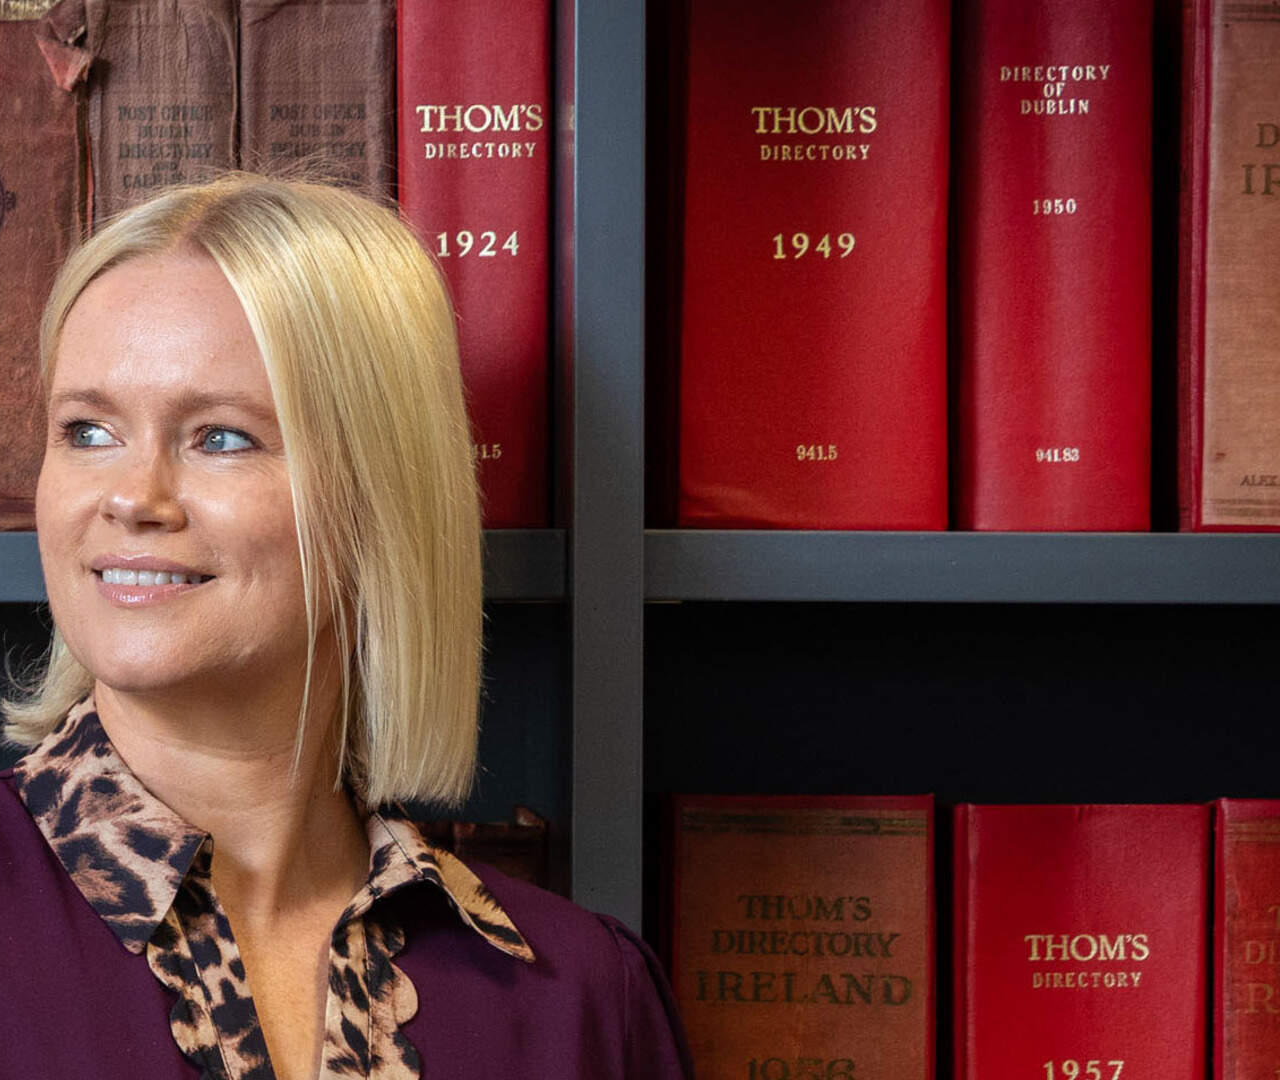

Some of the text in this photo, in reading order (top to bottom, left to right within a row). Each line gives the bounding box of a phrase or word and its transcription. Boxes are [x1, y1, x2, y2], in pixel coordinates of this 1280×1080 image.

[1001, 65, 1109, 82] DIRECTORY
[1044, 82, 1065, 98] OF
[1022, 99, 1088, 114] DUBLIN
[416, 105, 542, 132] THOM'S
[752, 106, 877, 134] THOM'S
[425, 142, 535, 159] DIRECTORY
[761, 144, 870, 160] DIRECTORY
[1034, 198, 1076, 214] 1950
[438, 231, 519, 257] 1924
[774, 233, 855, 259] 1949
[797, 445, 837, 460] 941.5
[1036, 448, 1079, 462] 941.83
[739, 893, 872, 922] THOM'S
[711, 932, 899, 958] DIRECTORY
[1025, 934, 1150, 961] THOM'S
[1034, 971, 1142, 988] DIRECTORY
[696, 971, 912, 1006] IRELAND
